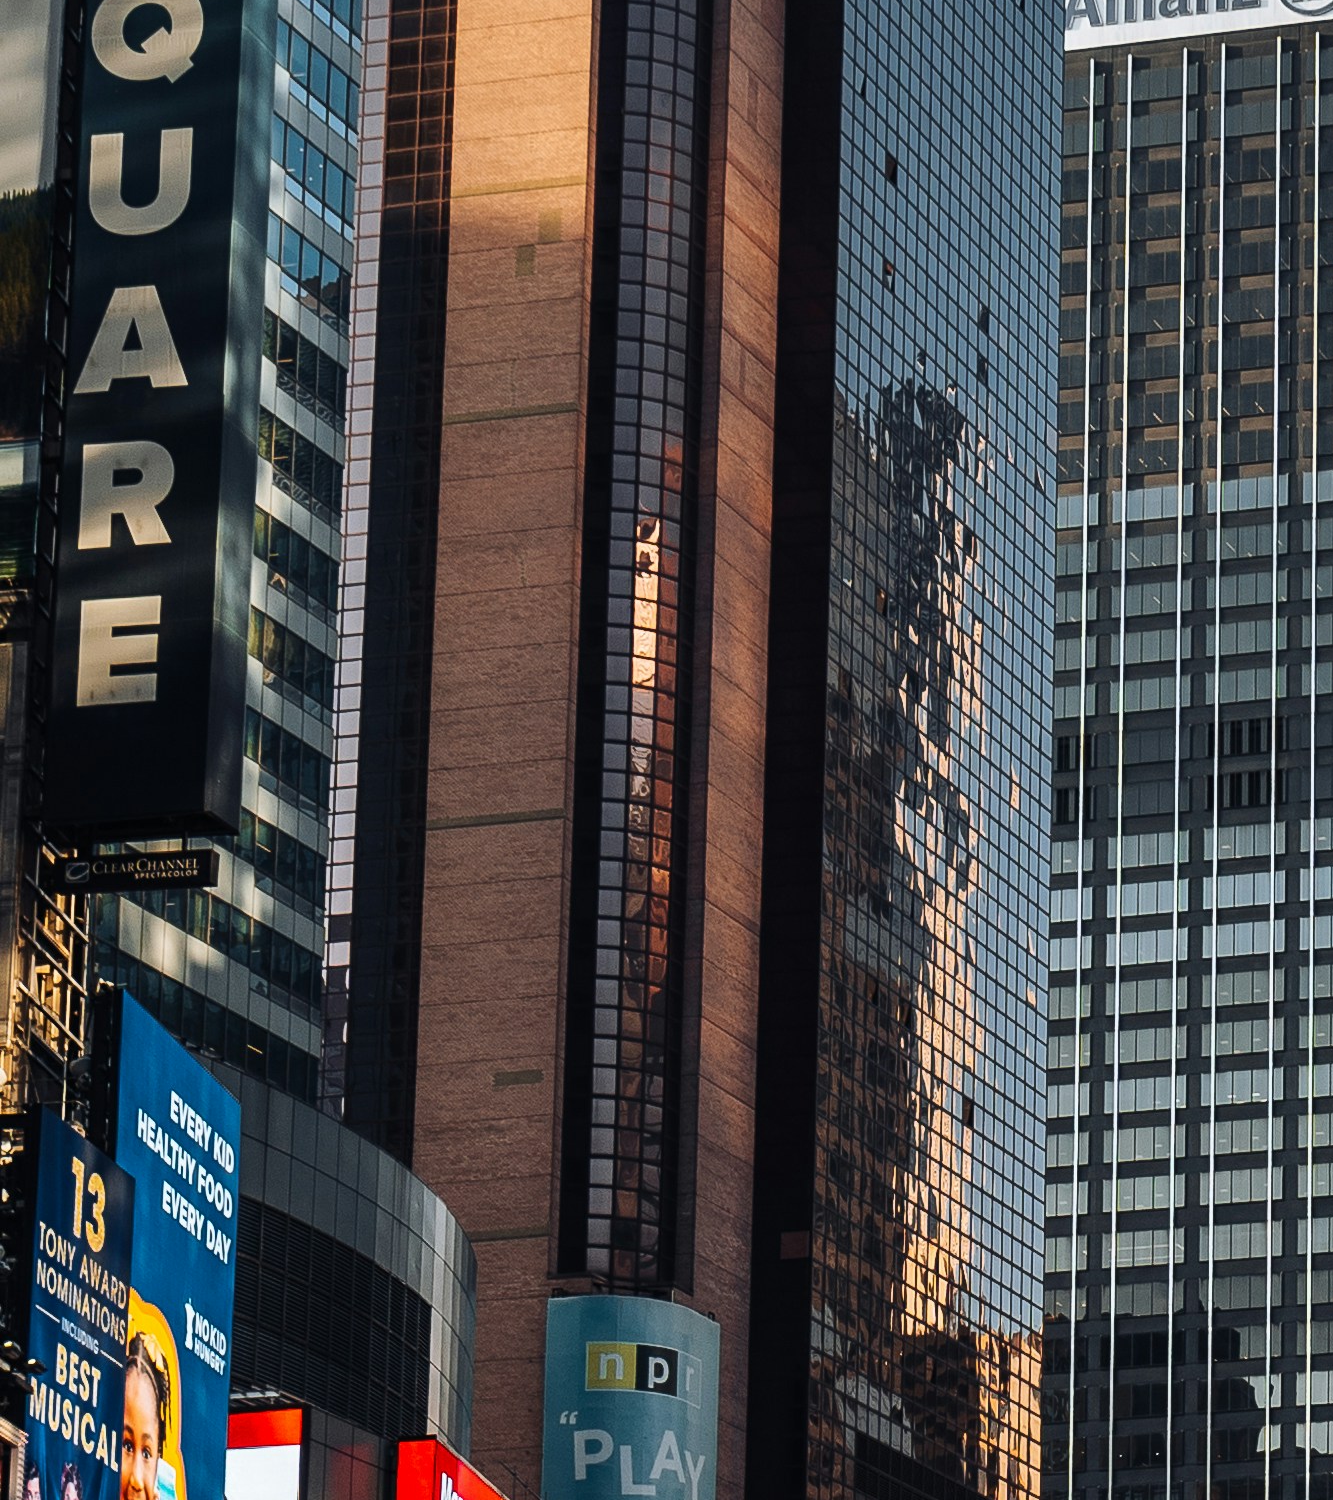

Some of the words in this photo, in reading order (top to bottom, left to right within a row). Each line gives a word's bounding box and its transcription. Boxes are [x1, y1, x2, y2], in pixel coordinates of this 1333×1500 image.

[137, 1109, 196, 1186] HEALTHY
[198, 1165, 233, 1219] FOOD
[170, 1091, 210, 1153] EVERY
[213, 1133, 235, 1174] KID
[71, 1156, 106, 1253] 13
[162, 1180, 203, 1243] EVERY
[206, 1226, 232, 1264] DAY
[36, 1265, 127, 1346] NOMINATIONS
[38, 1221, 75, 1268] TONY
[79, 1254, 128, 1309] AWARD
[61, 1317, 99, 1354] INCLUDING
[194, 1336, 226, 1375] HUNGRY
[195, 1311, 209, 1344] NO
[210, 1324, 227, 1356] KID
[599, 1351, 694, 1391] npr
[55, 1344, 101, 1407] BEST
[28, 1379, 119, 1473] MUSICAL
